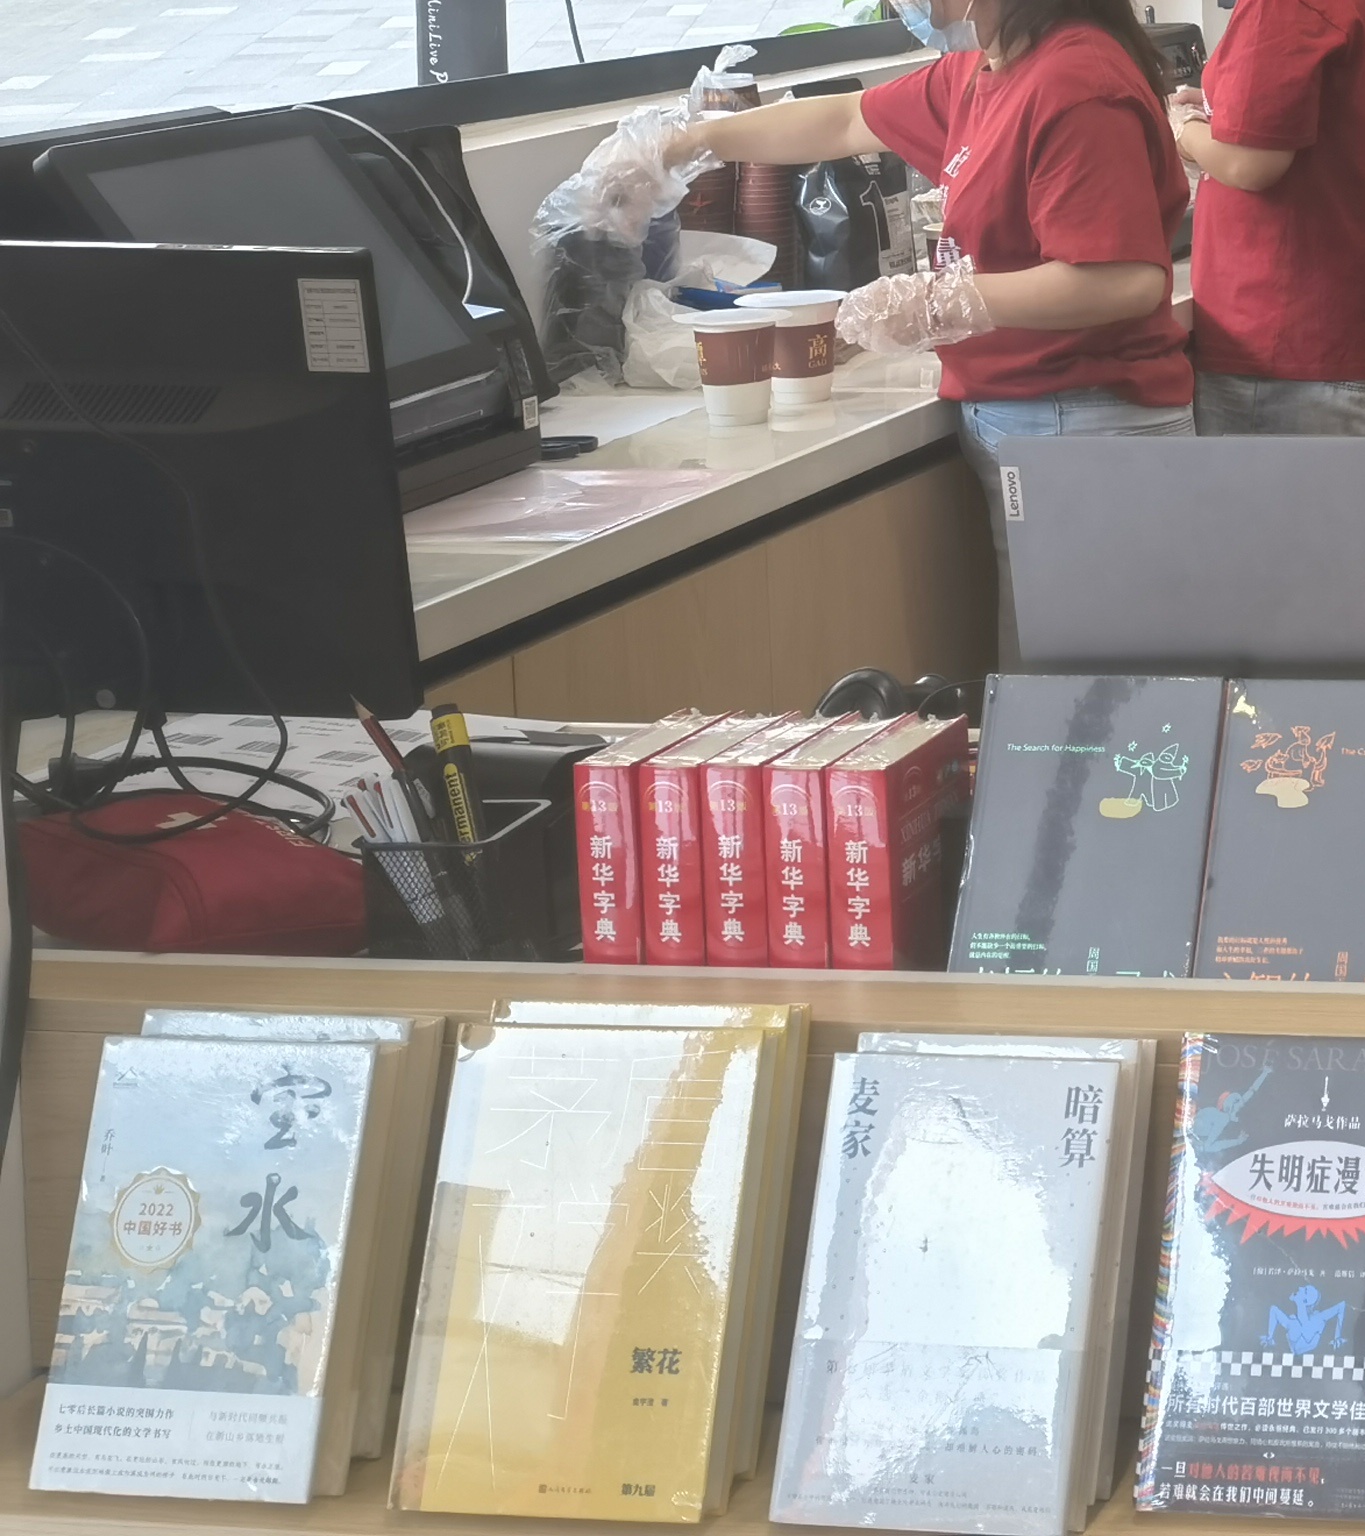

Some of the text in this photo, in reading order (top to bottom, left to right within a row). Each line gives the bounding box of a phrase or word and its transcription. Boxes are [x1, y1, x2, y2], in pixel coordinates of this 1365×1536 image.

[808, 334, 828, 359] 高
[1006, 470, 1018, 519] Lenovo
[1007, 743, 1020, 751] The
[1052, 743, 1063, 752] for
[1065, 744, 1105, 753] Happiness
[1341, 747, 1356, 755] The
[590, 836, 617, 942] 新华字典
[656, 836, 682, 943] 新华字典
[718, 835, 745, 942] 新华字典
[780, 839, 805, 946] 新华字典
[845, 840, 871, 947] 新华字典
[839, 1077, 881, 1161] 麦家
[1058, 1084, 1103, 1169] 暗算
[1284, 1115, 1361, 1130] 萨拉马戈作品
[226, 1066, 332, 1254] 宝水
[123, 1220, 183, 1237] 中国好书
[139, 1201, 173, 1217] 2022
[630, 1345, 683, 1376] 繁花
[621, 1482, 656, 1497] 第九届
